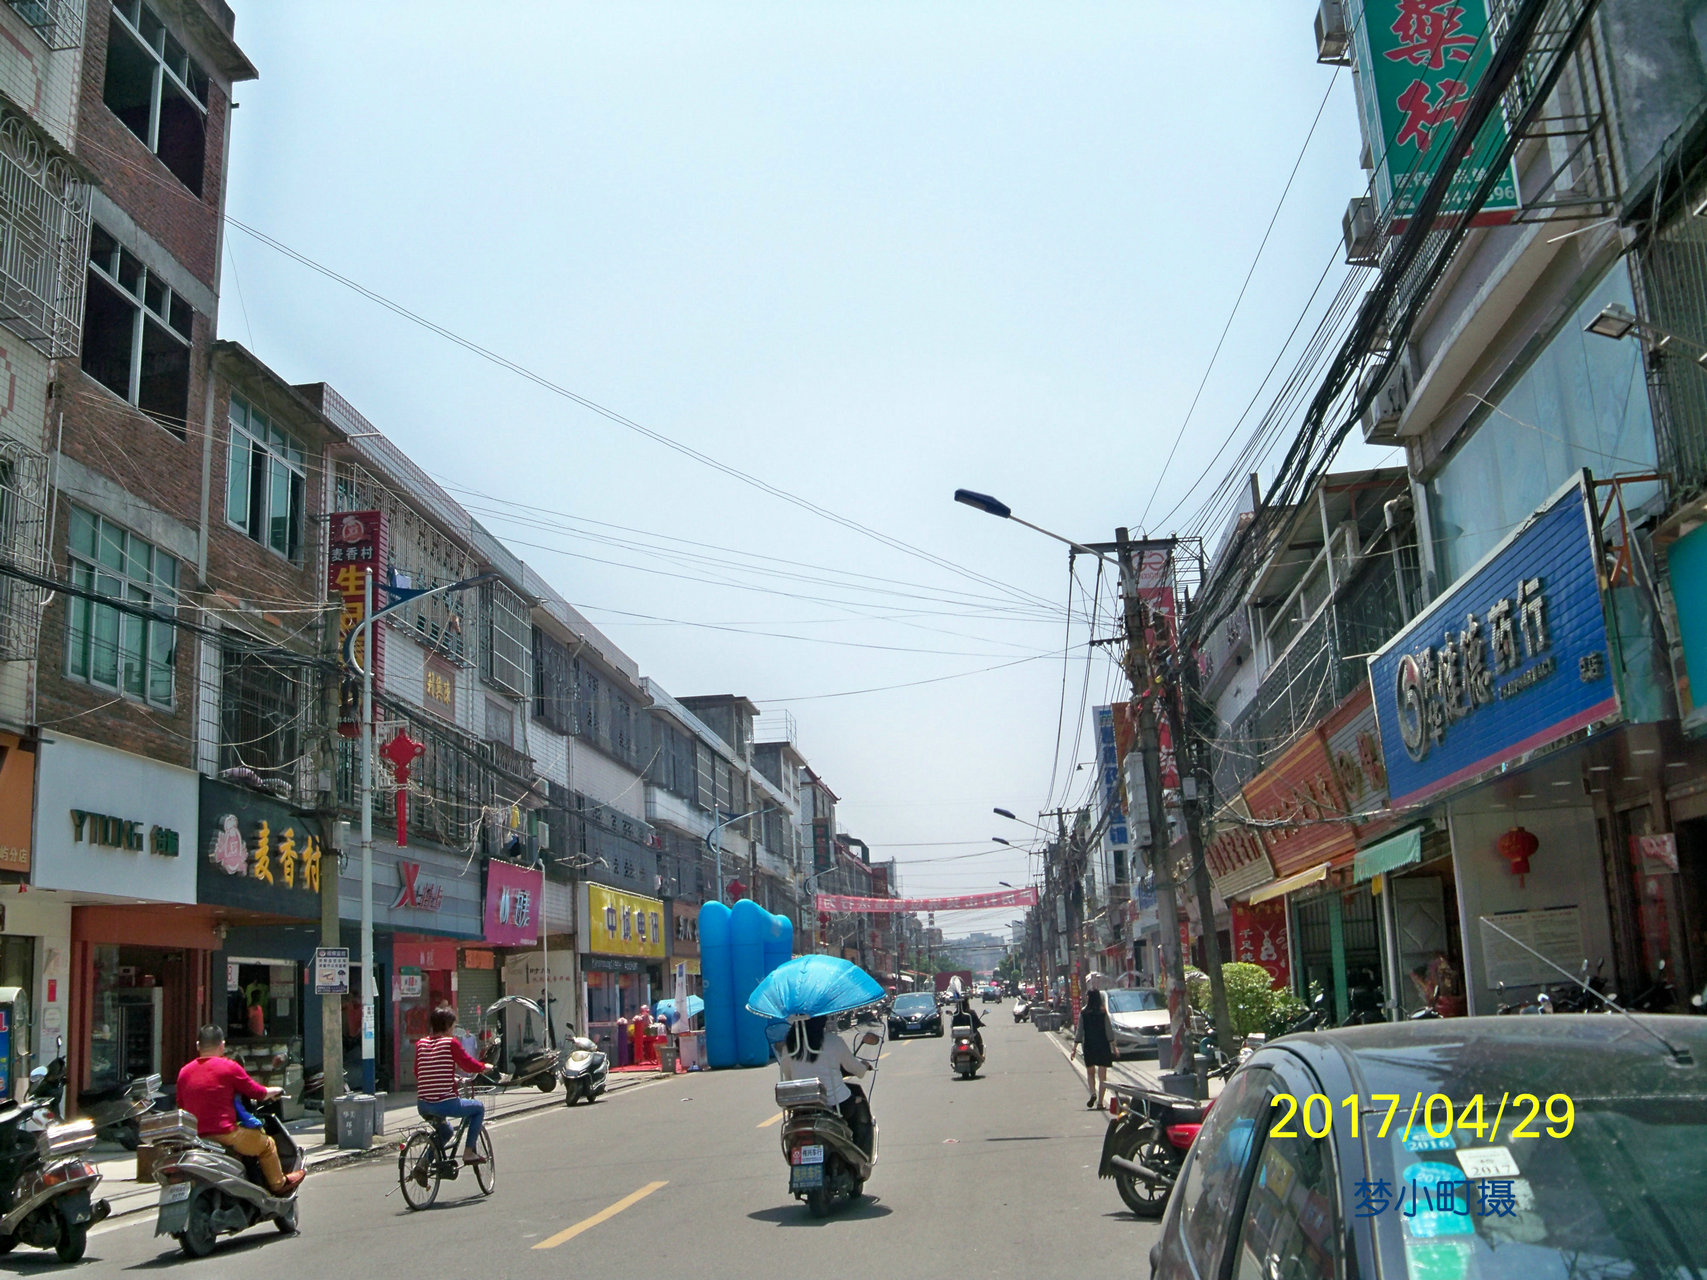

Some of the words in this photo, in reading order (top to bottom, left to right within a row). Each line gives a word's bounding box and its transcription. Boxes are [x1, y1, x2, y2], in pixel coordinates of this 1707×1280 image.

[331, 546, 373, 562] 麦香村
[1408, 1140, 1450, 1151] 2016
[1471, 1164, 1512, 1176] 2017
